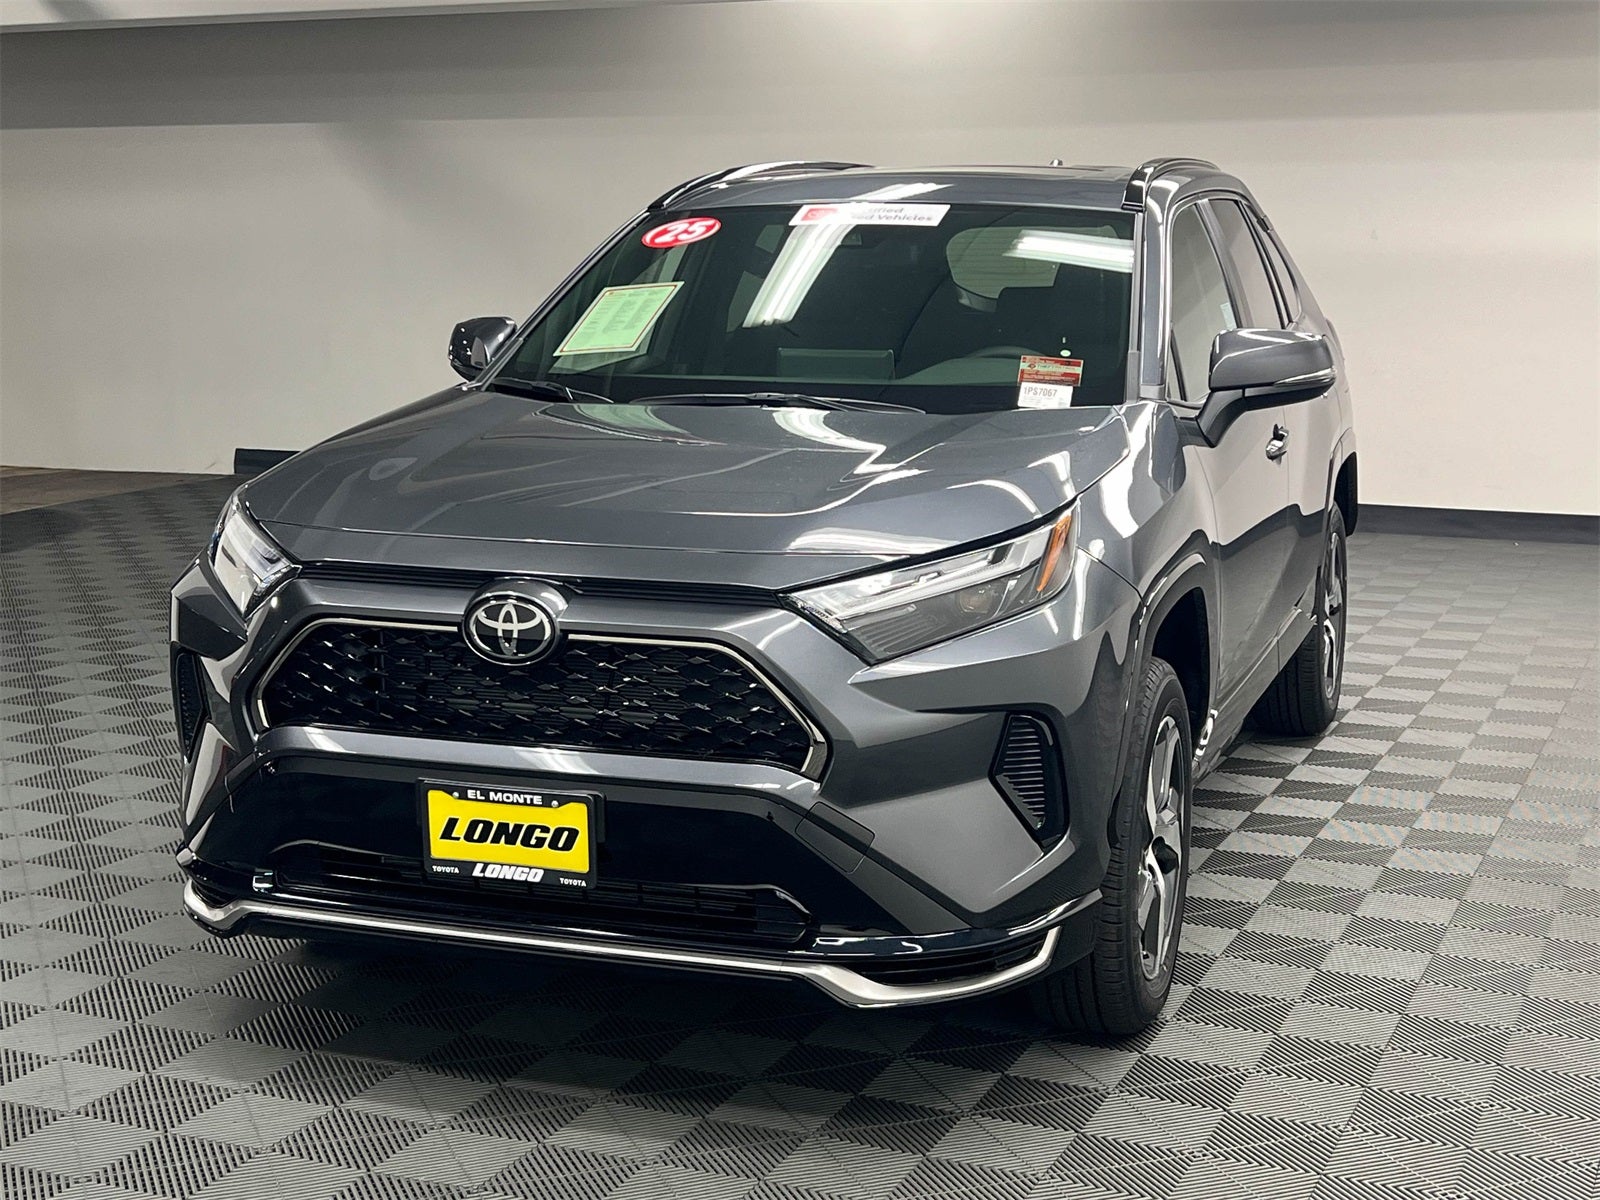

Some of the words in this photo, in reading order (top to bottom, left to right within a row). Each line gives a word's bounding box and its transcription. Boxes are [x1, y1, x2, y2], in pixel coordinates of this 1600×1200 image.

[877, 214, 933, 222] Vehicles
[654, 219, 715, 244] 25
[1024, 386, 1058, 397] 1PS7067
[467, 789, 485, 800] EL
[489, 791, 543, 805] MONTE
[439, 817, 580, 852] LONGO
[432, 865, 459, 874] TOYOTA
[472, 862, 545, 883] LONGO
[559, 877, 587, 887] TOYOTA
